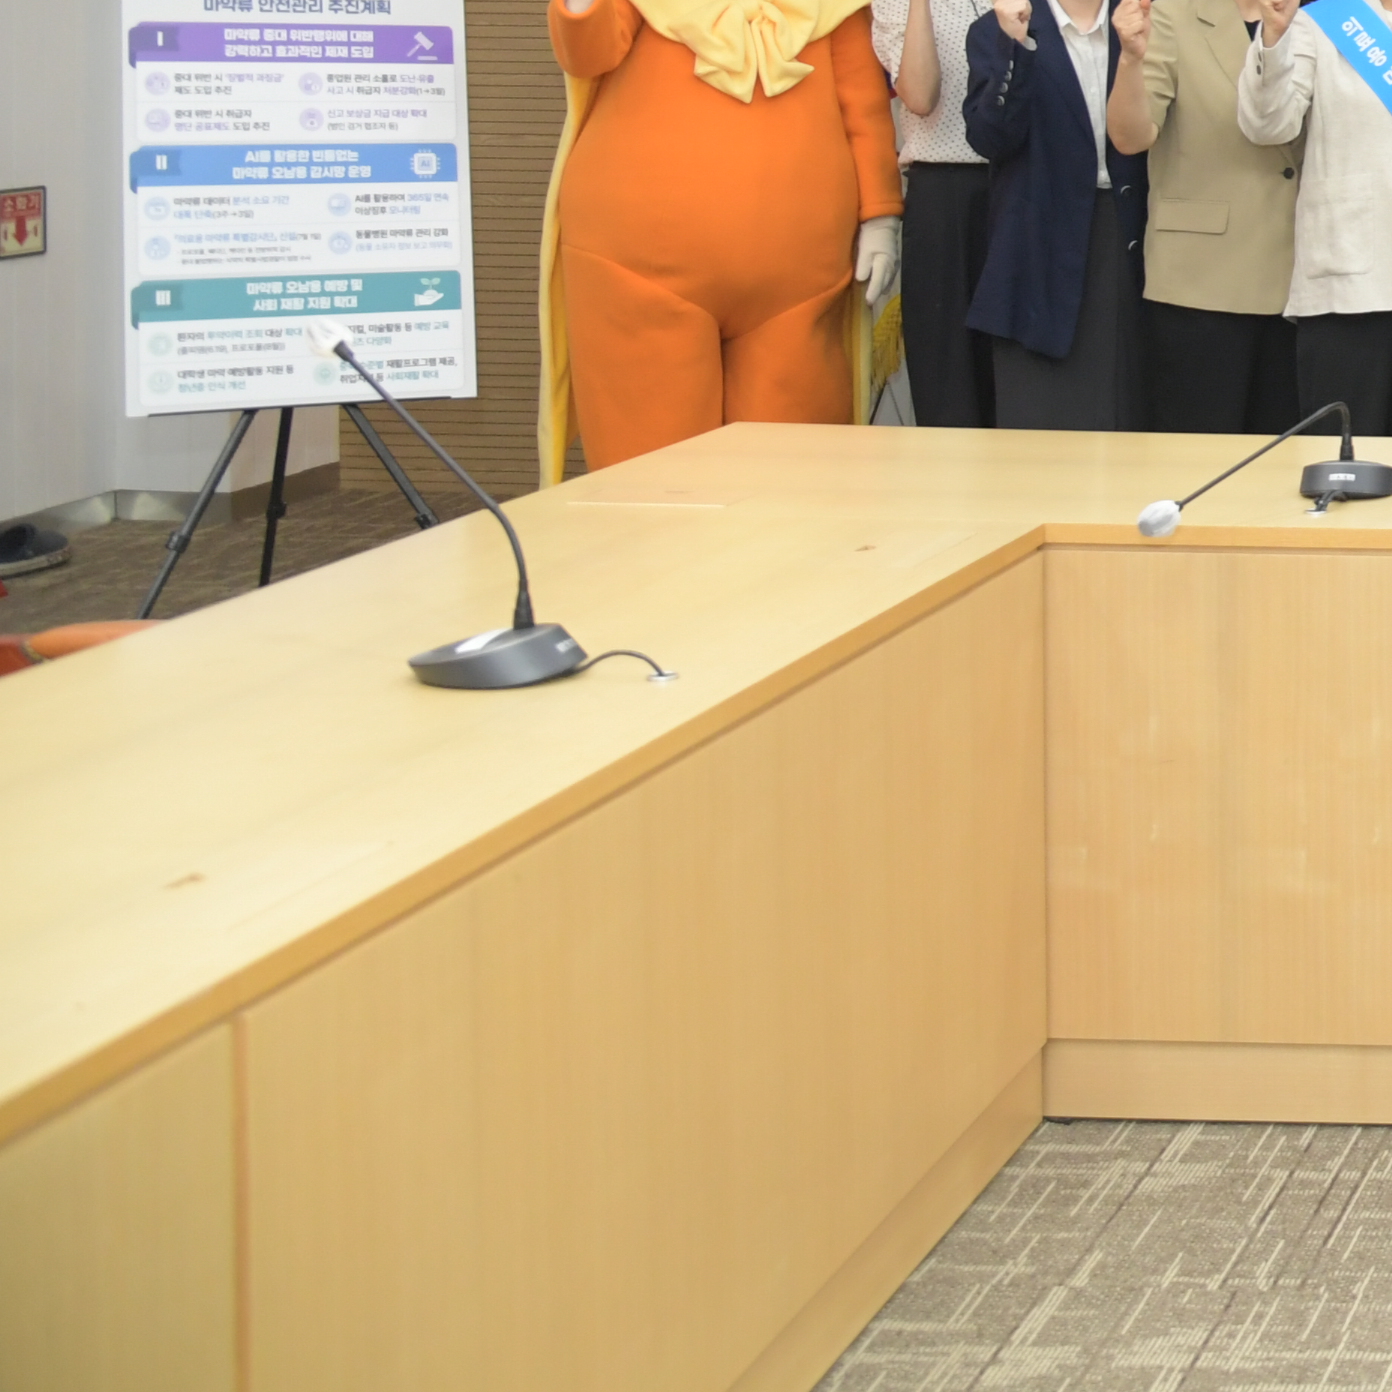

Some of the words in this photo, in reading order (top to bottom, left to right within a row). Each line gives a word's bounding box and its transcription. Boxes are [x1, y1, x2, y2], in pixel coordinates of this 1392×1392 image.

[224, 28, 260, 42] 마약류
[350, 29, 374, 43] 대해
[1341, 16, 1387, 67] 의료용
[275, 45, 322, 58] 효과적인
[325, 45, 349, 59] 제재
[351, 45, 374, 59] 도입
[232, 167, 269, 179] 마약류
[348, 165, 371, 178] 운영
[247, 281, 283, 295] 마약류
